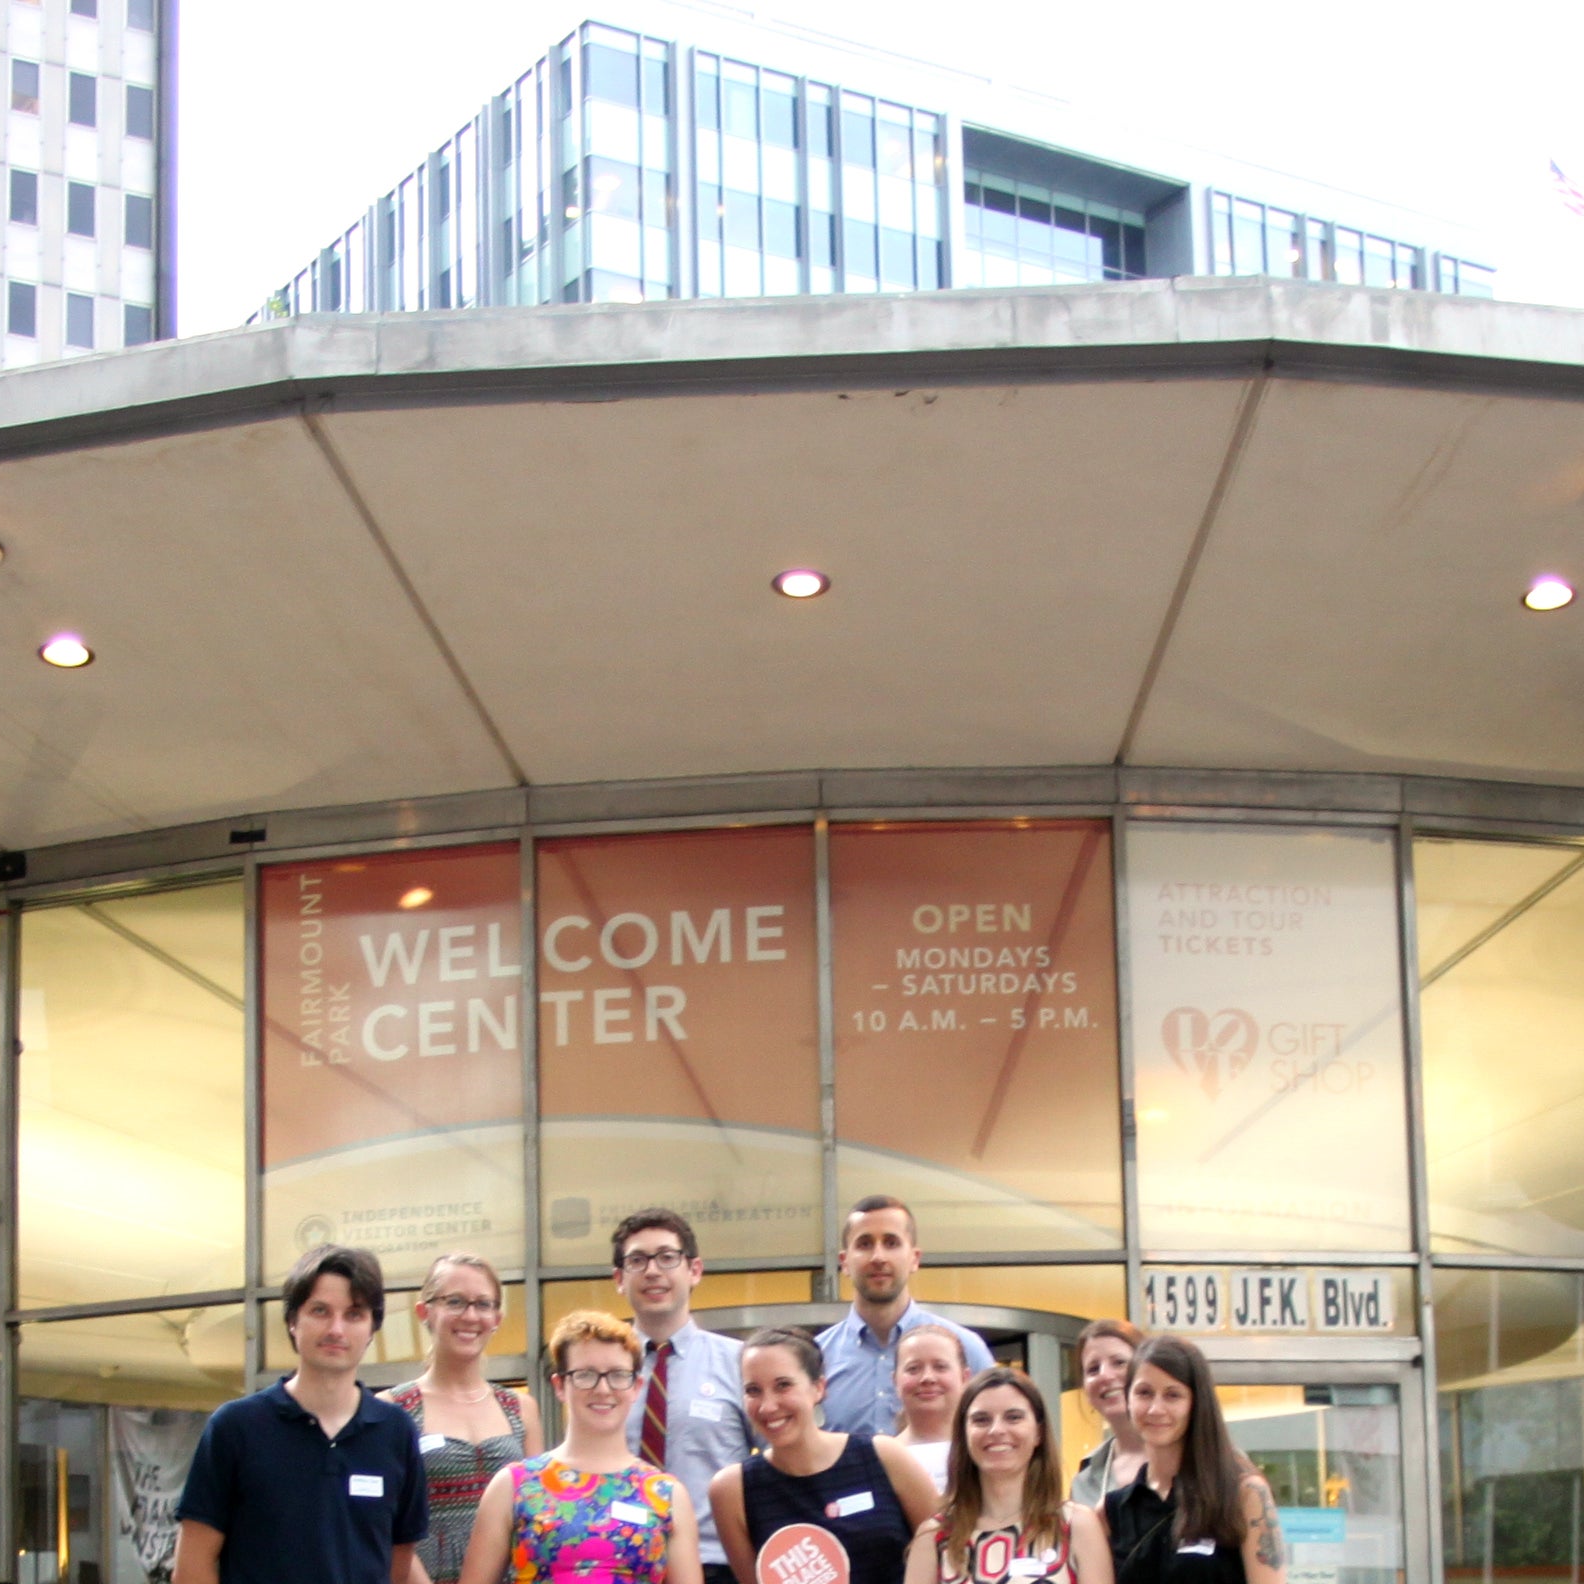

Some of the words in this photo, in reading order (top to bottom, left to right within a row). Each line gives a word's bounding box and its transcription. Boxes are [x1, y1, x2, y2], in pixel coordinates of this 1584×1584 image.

[1158, 881, 1332, 906] ATTRACTION
[912, 903, 1032, 934] OPEN
[1158, 909, 1216, 929] AND
[1231, 910, 1304, 931] TOUR
[359, 905, 787, 987] WELCOME
[896, 946, 1052, 969] MONDAYS
[1159, 934, 1273, 956] TICKETS
[300, 874, 323, 1067] FAIRMOUNT
[902, 972, 1078, 996] SATURDAYS
[329, 982, 352, 1065] PARK
[361, 985, 688, 1062] CENTER
[853, 1009, 887, 1032] 10
[898, 1009, 966, 1031] A.M.
[1011, 1008, 1026, 1029] 5
[1039, 1006, 1098, 1029] P.M.
[1268, 1021, 1348, 1055] GIFT
[1269, 1058, 1375, 1094] SHOP
[341, 1201, 483, 1224] INDEPENDENCE
[344, 1222, 417, 1241] VISITOR
[422, 1219, 493, 1236] CENTER
[1145, 1275, 1218, 1325] 1599
[1236, 1276, 1306, 1326] J.F.K.
[1324, 1278, 1389, 1327] Blvd.
[768, 1536, 821, 1579] THIS
